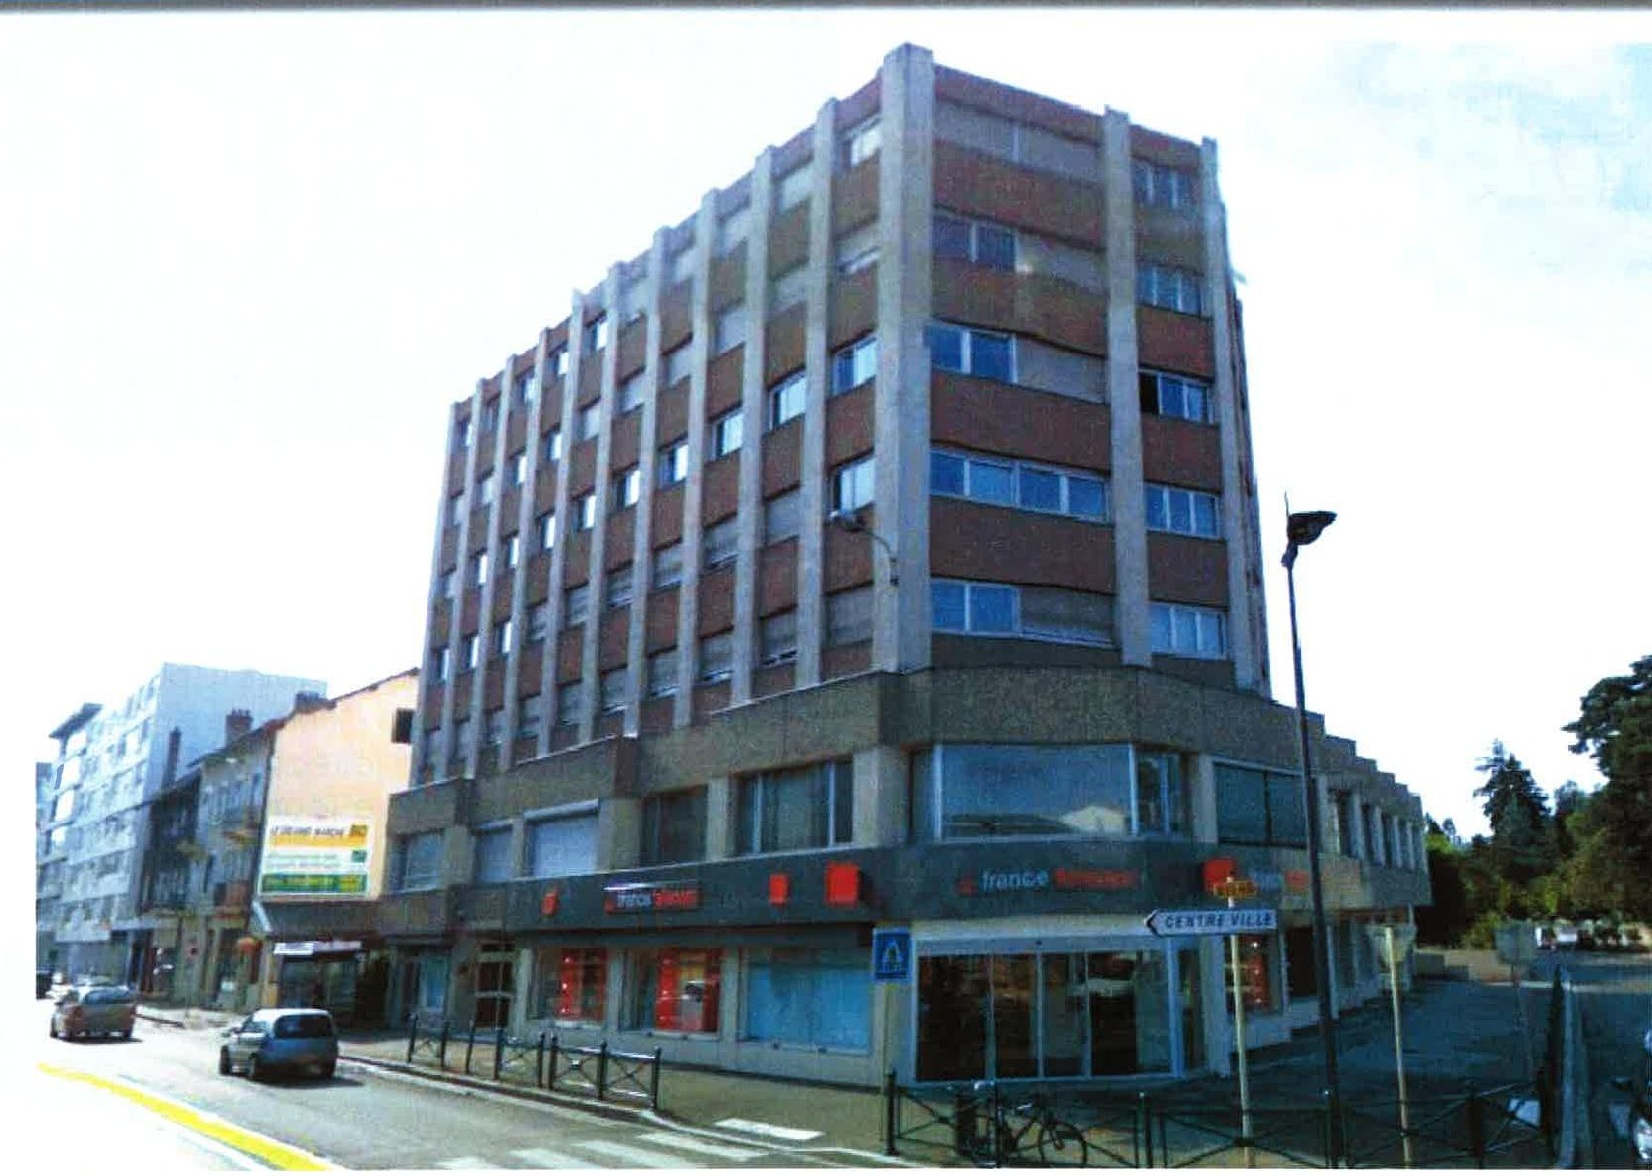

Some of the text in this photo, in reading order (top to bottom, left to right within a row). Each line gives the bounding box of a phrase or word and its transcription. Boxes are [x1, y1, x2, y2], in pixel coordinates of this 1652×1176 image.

[981, 868, 1050, 892] france
[1165, 912, 1272, 929] CENTRE VILLE
